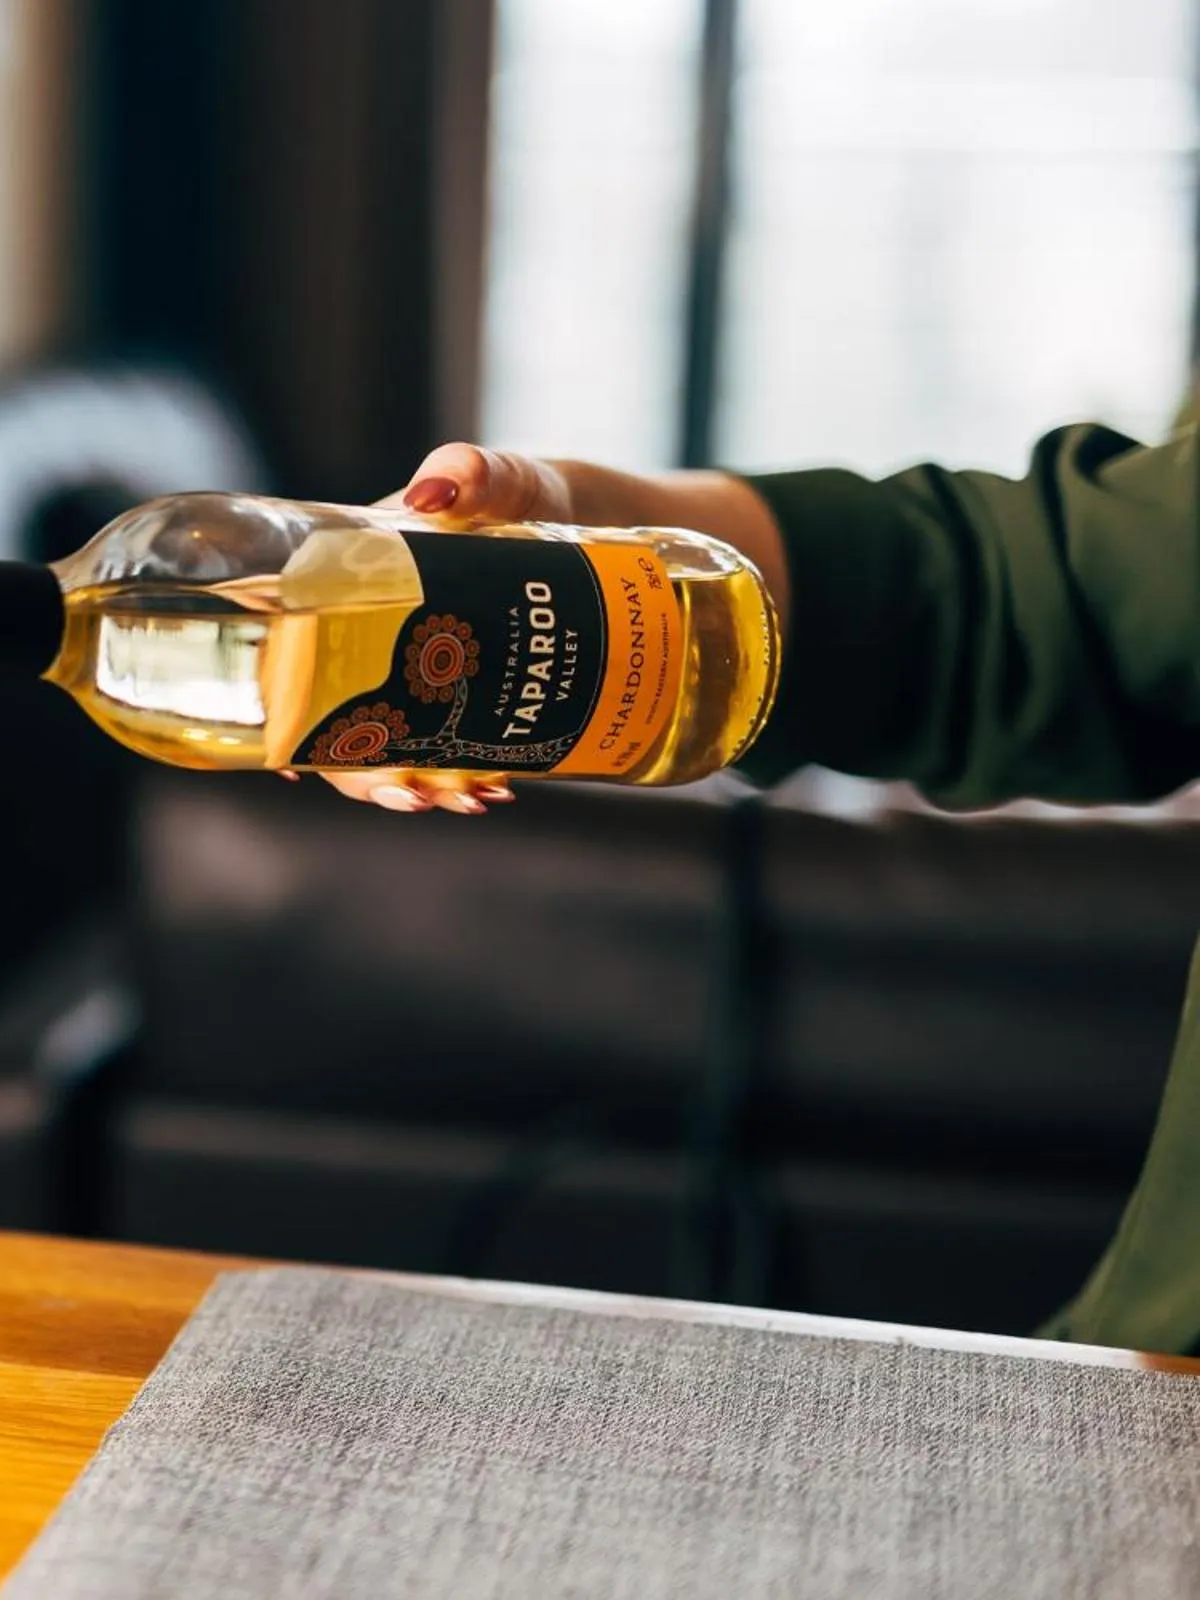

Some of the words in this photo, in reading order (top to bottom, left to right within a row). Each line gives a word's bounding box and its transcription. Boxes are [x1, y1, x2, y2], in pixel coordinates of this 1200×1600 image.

[494, 606, 520, 716] AUSTRALIA
[502, 581, 556, 739] TAPAROO
[556, 629, 579, 701] VALLEY
[599, 577, 645, 750] CHARDONNAY
[660, 612, 670, 659] AUSTRALIA
